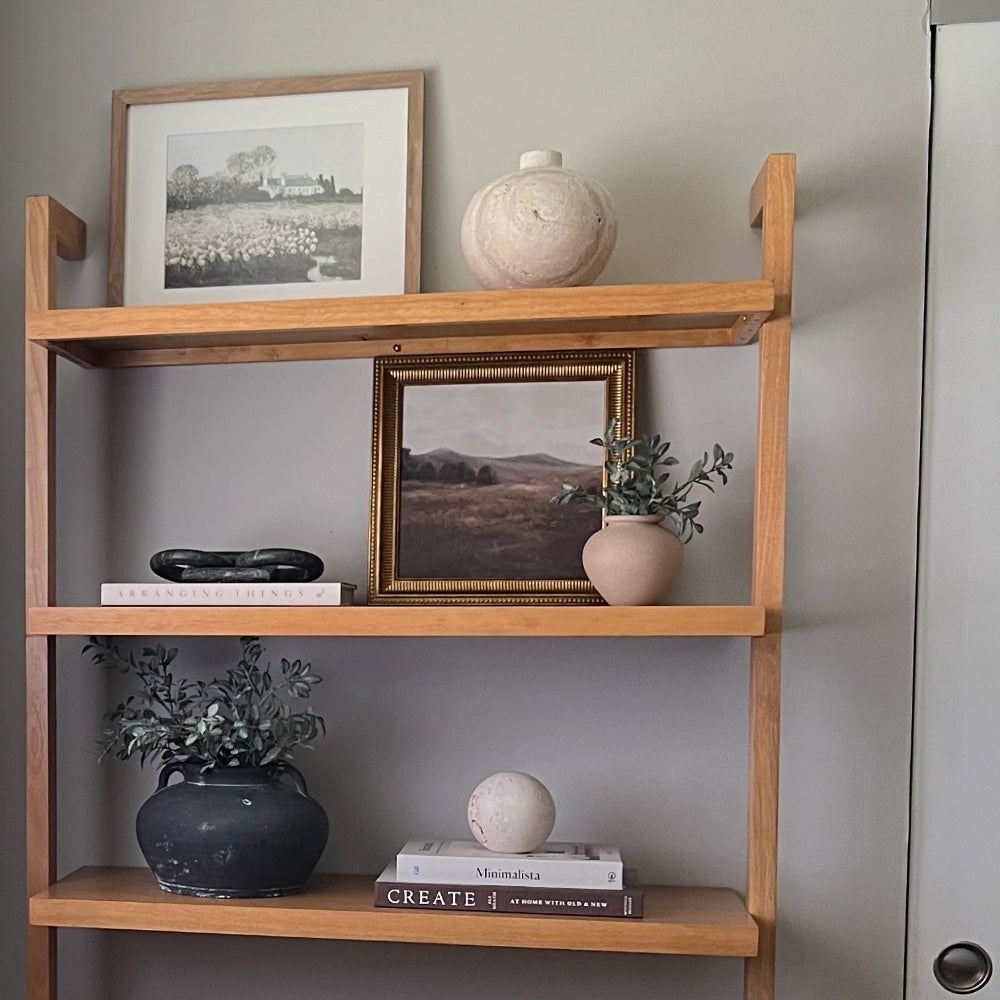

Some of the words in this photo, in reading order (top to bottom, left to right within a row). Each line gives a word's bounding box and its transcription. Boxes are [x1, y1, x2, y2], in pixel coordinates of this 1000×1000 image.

[116, 589, 224, 599] ARRANGING
[234, 589, 305, 599] THINGS
[476, 867, 541, 881] Minimalista
[387, 889, 476, 907] CREATE
